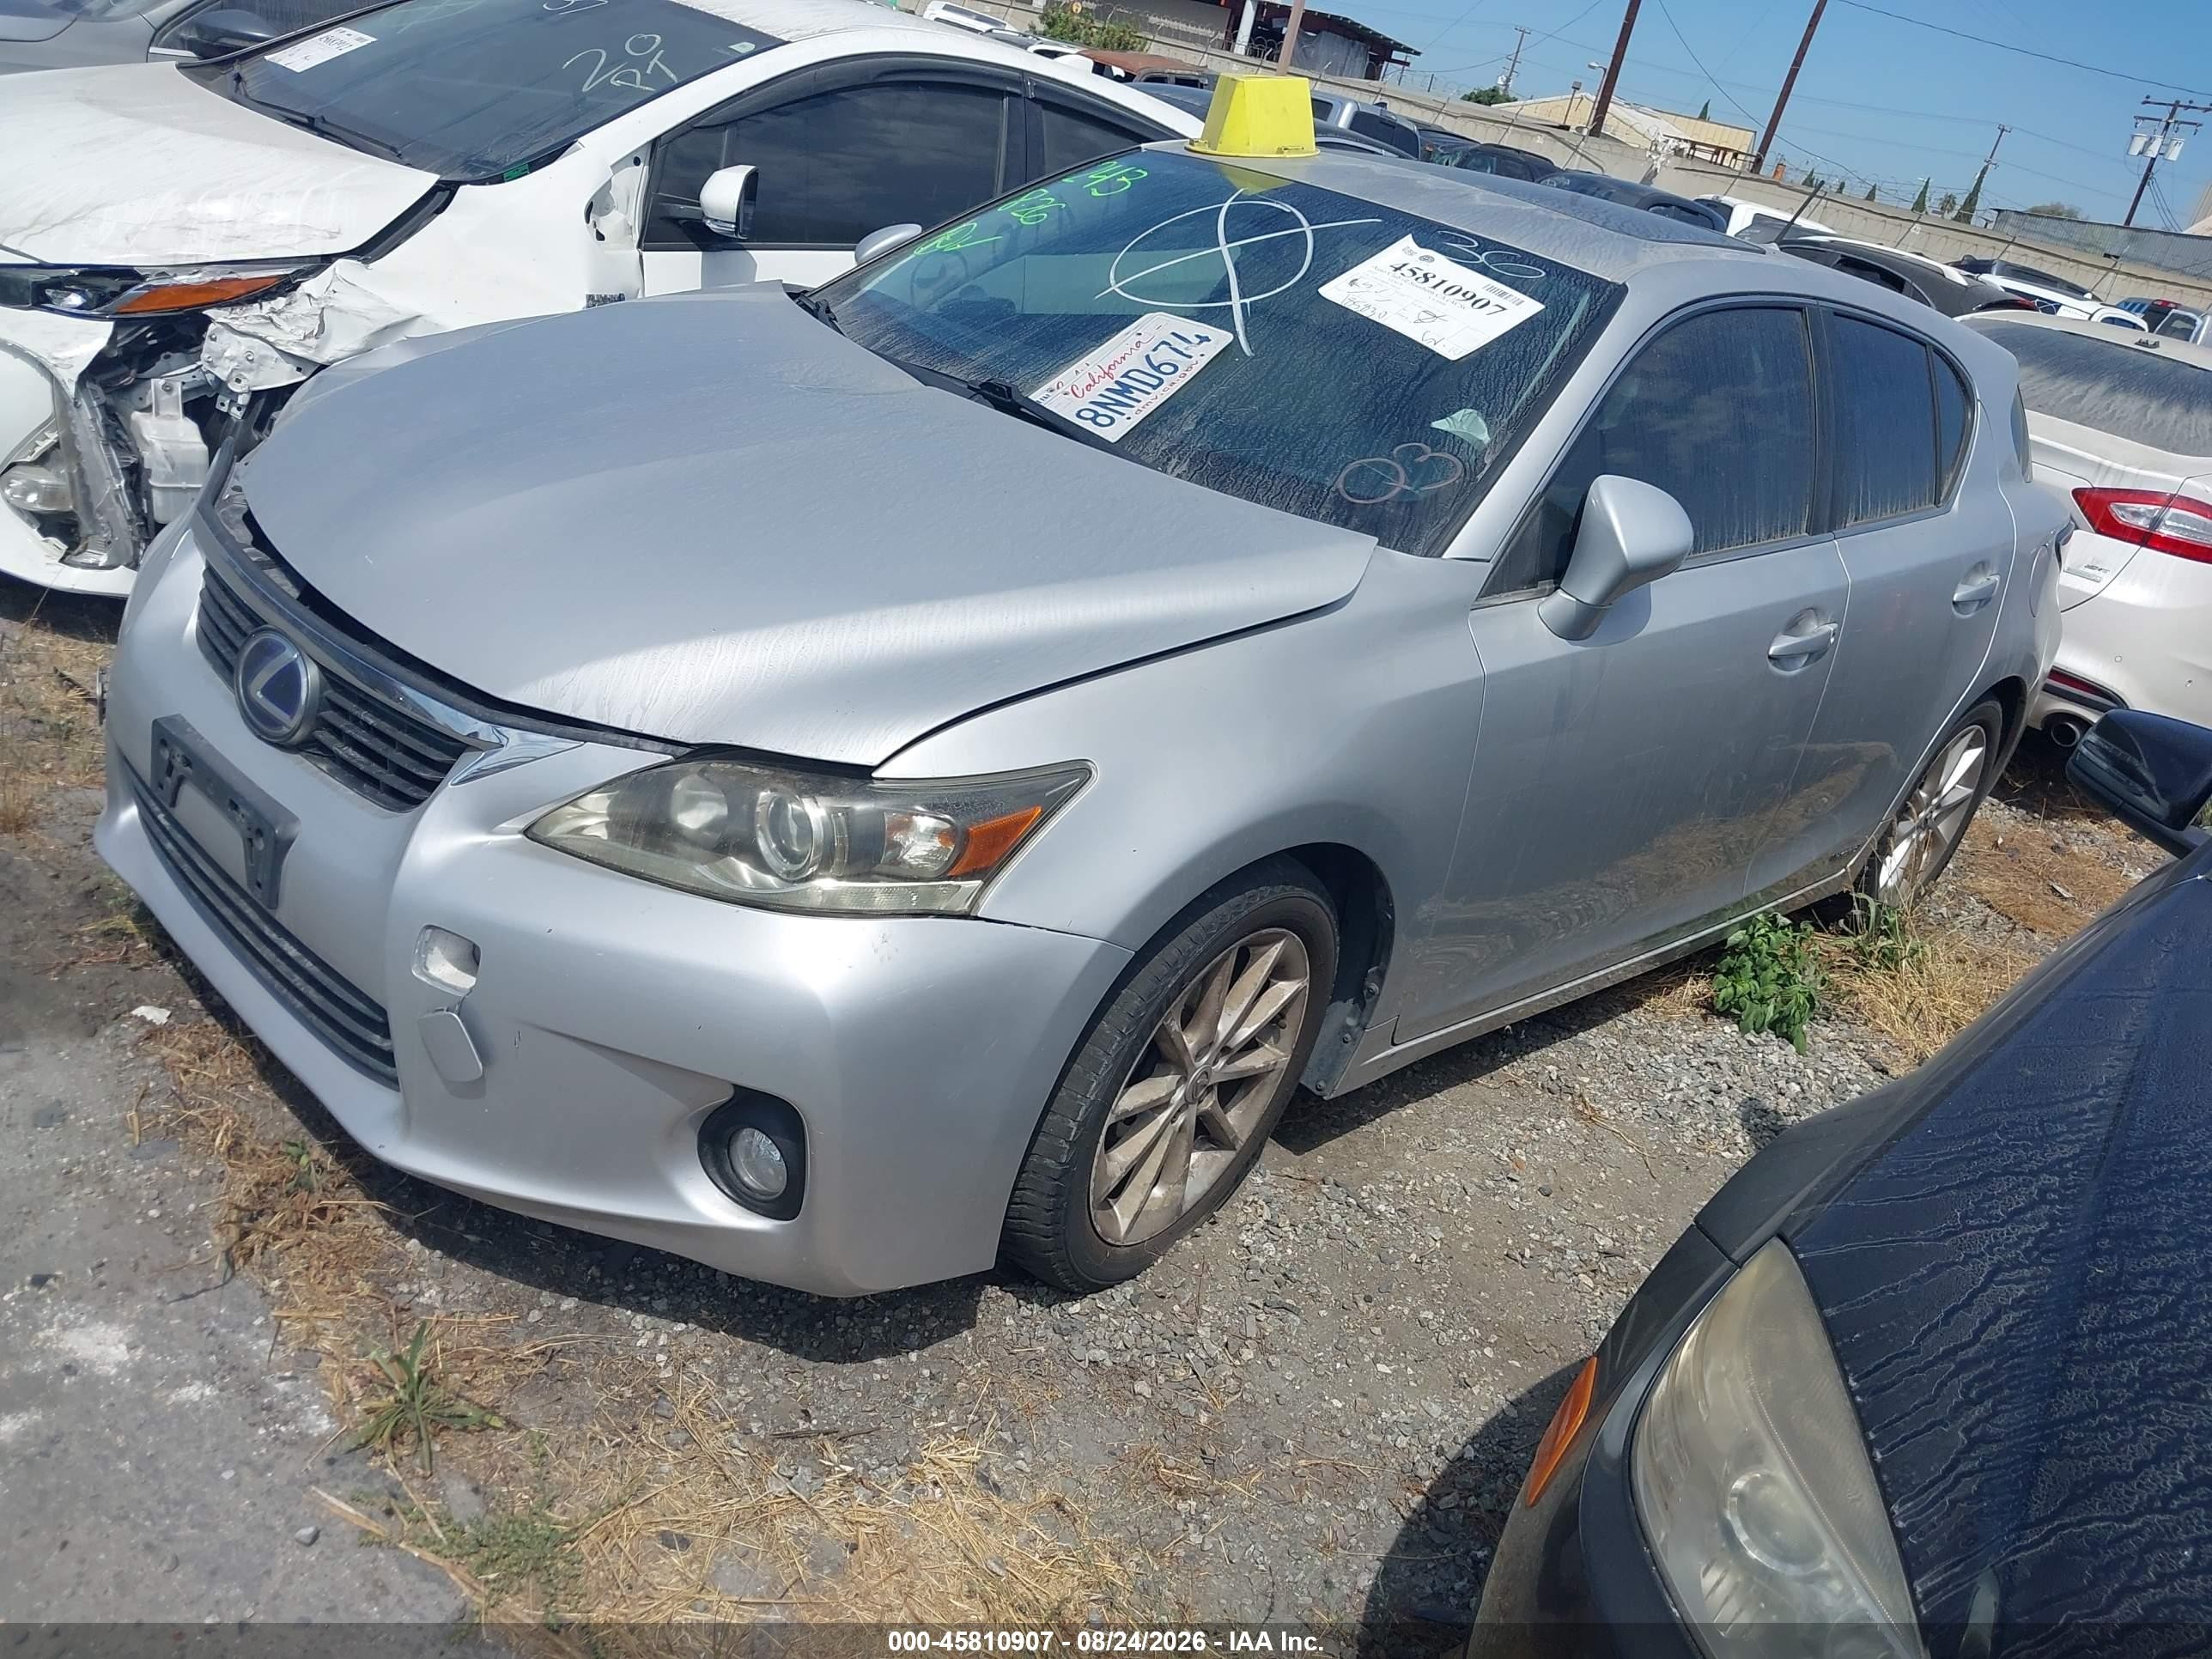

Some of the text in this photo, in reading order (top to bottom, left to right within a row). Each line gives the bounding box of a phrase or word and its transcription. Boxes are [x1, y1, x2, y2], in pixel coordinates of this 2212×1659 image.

[1389, 262, 1509, 316] 45810907
[1071, 336, 1156, 400] California
[1075, 331, 1212, 428] 8NMD674
